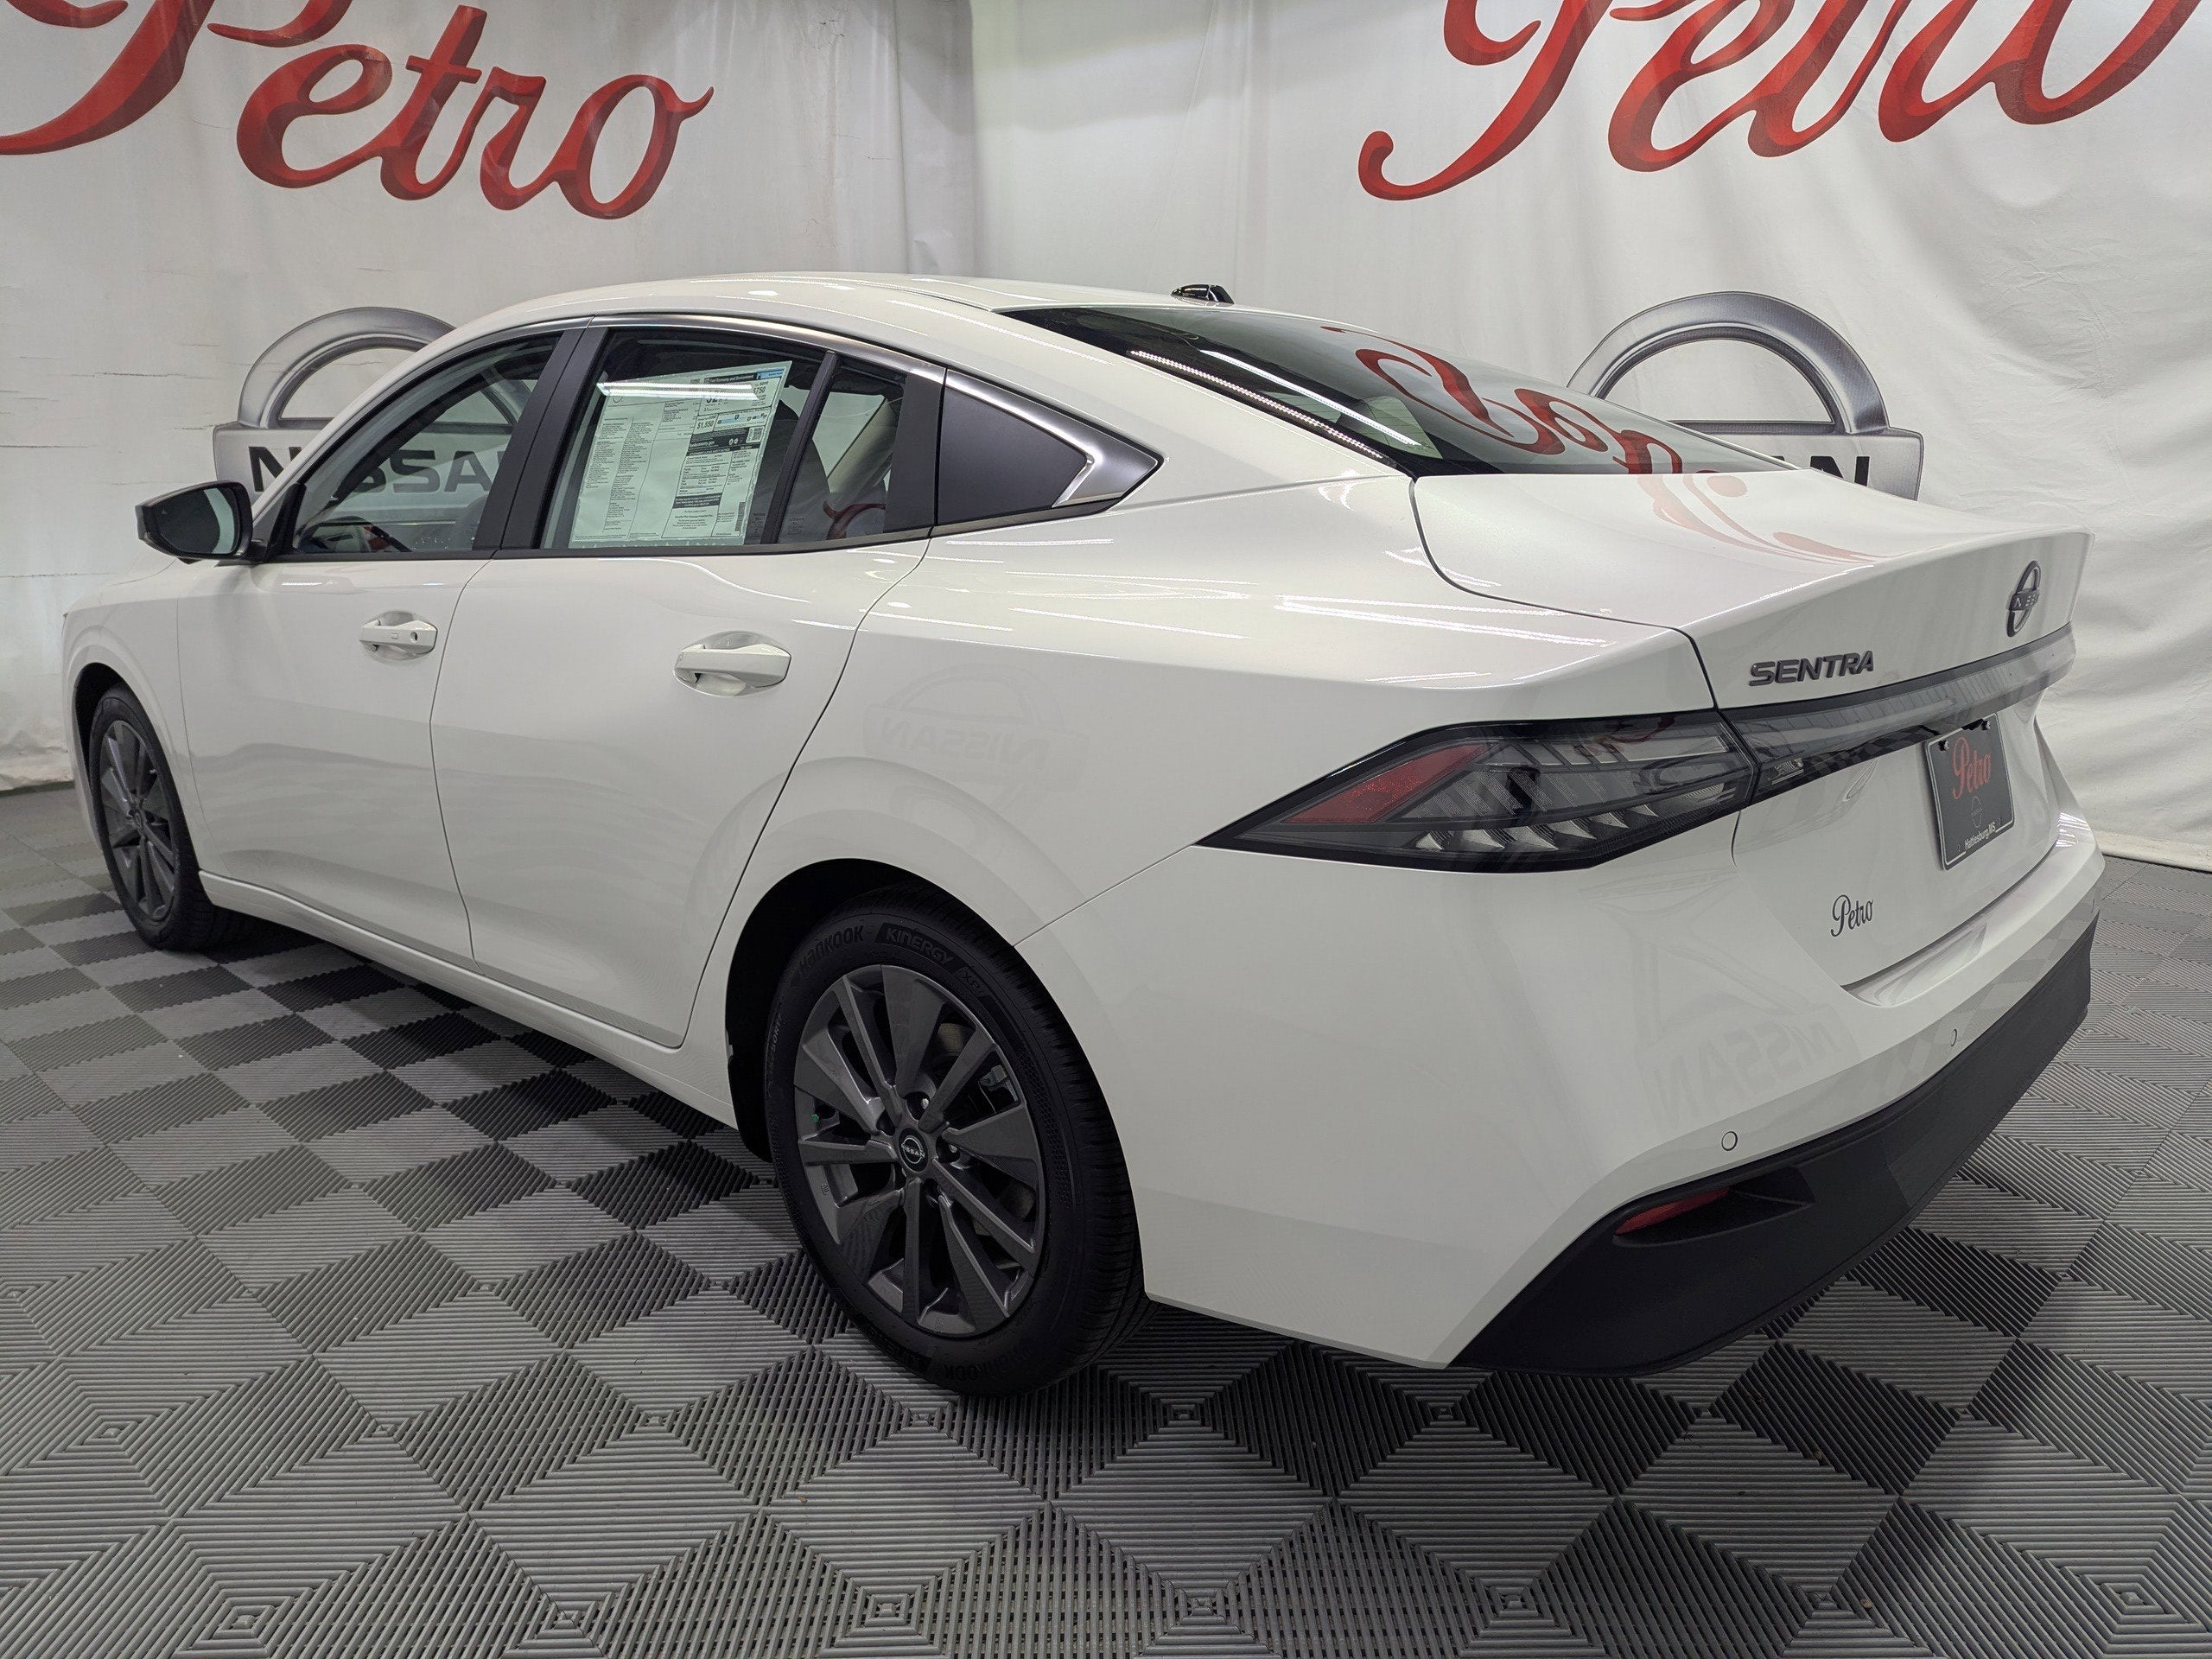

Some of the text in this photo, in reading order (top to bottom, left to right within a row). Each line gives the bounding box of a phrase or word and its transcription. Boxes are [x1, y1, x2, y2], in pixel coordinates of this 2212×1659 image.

[248, 446, 505, 493] NSA
[1749, 651, 1874, 687] SENTRA
[1952, 736, 1992, 800] Petro
[1830, 894, 1874, 938] Petro
